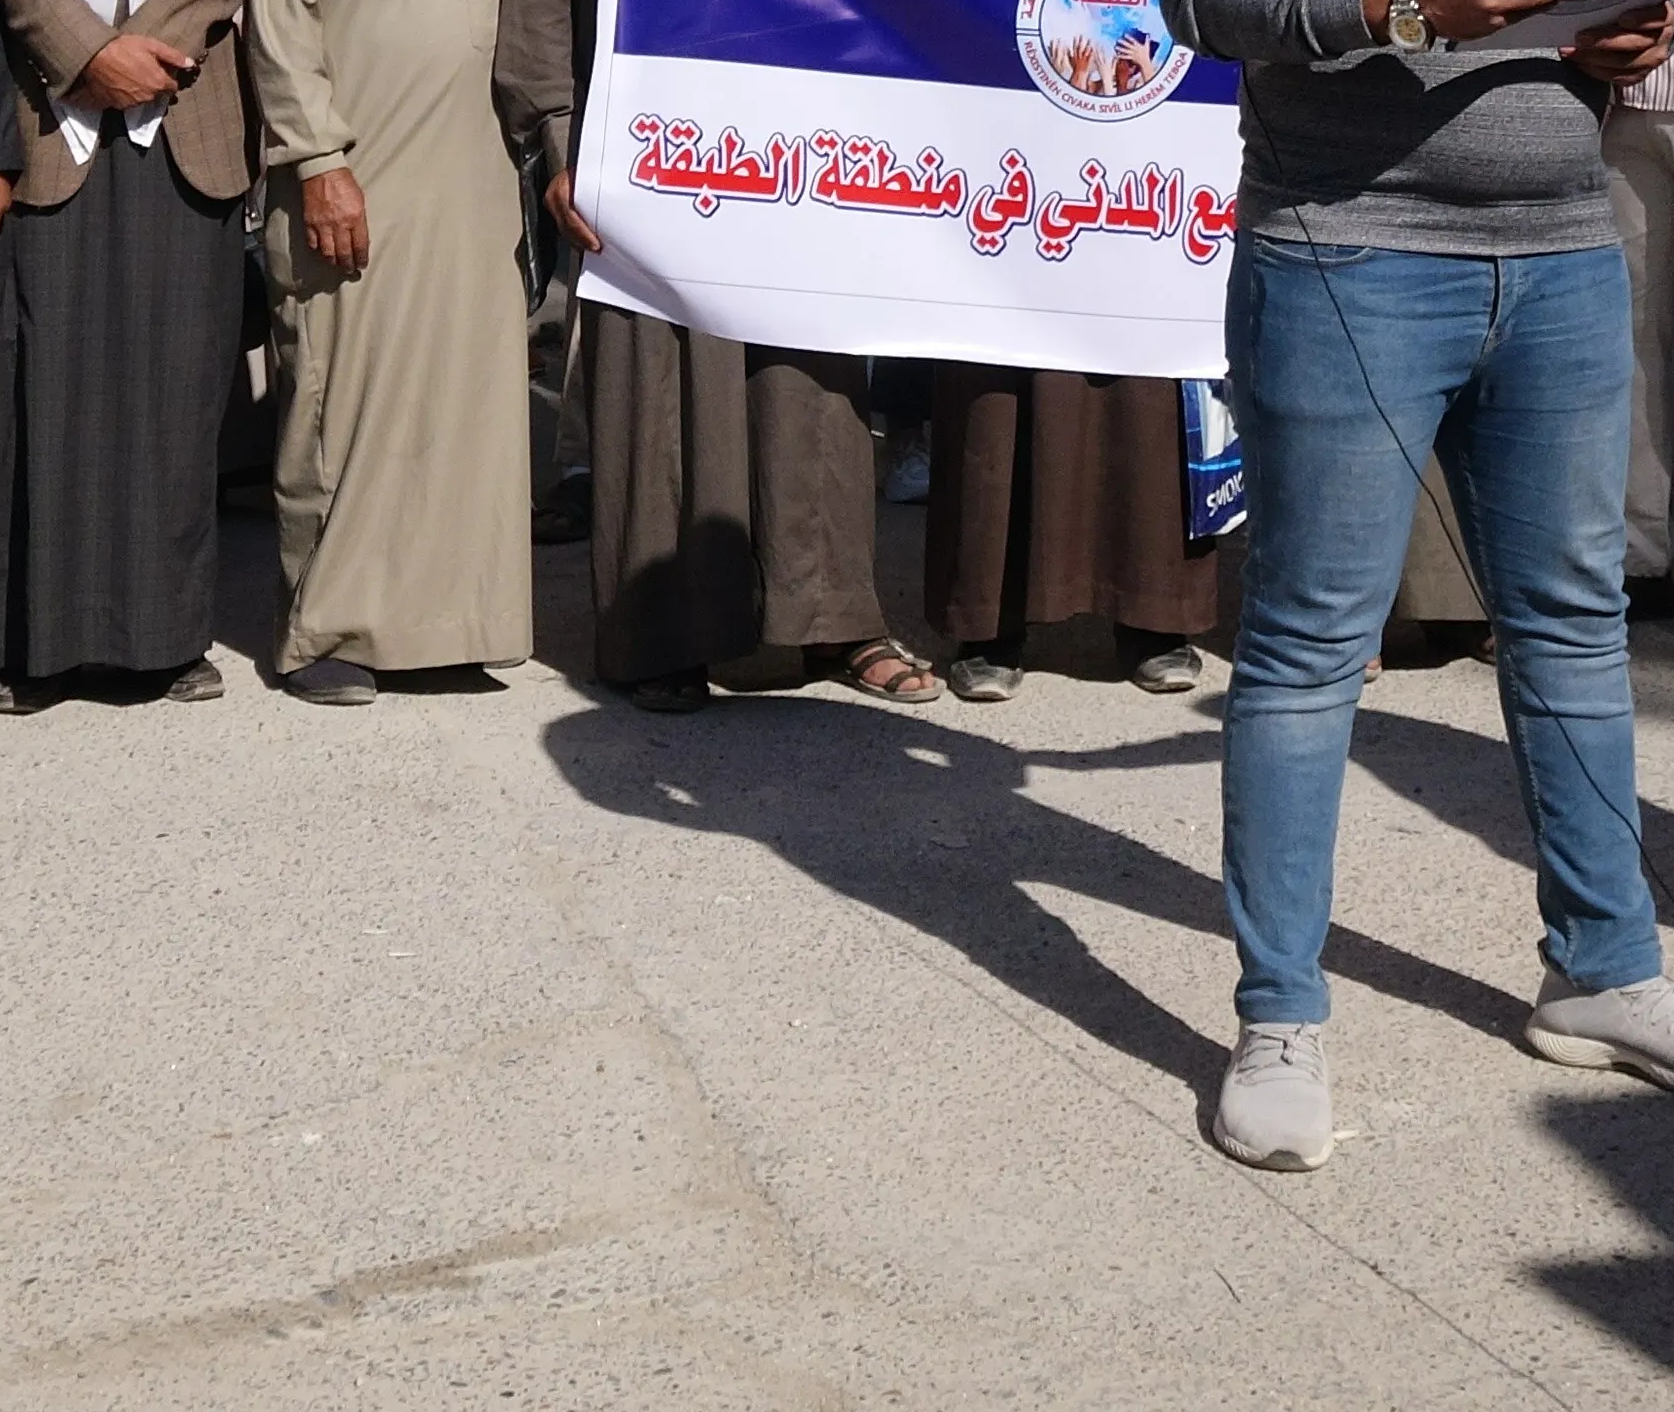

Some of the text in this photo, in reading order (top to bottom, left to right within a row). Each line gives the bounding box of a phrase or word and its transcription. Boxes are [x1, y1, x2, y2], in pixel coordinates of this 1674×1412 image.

[1061, 92, 1096, 112] CIVAKA
[633, 117, 805, 212] الطبقة
[811, 131, 964, 212] منطقة
[971, 154, 1030, 248] في
[1038, 161, 1179, 253] المدني
[1206, 471, 1244, 518] SMOK
